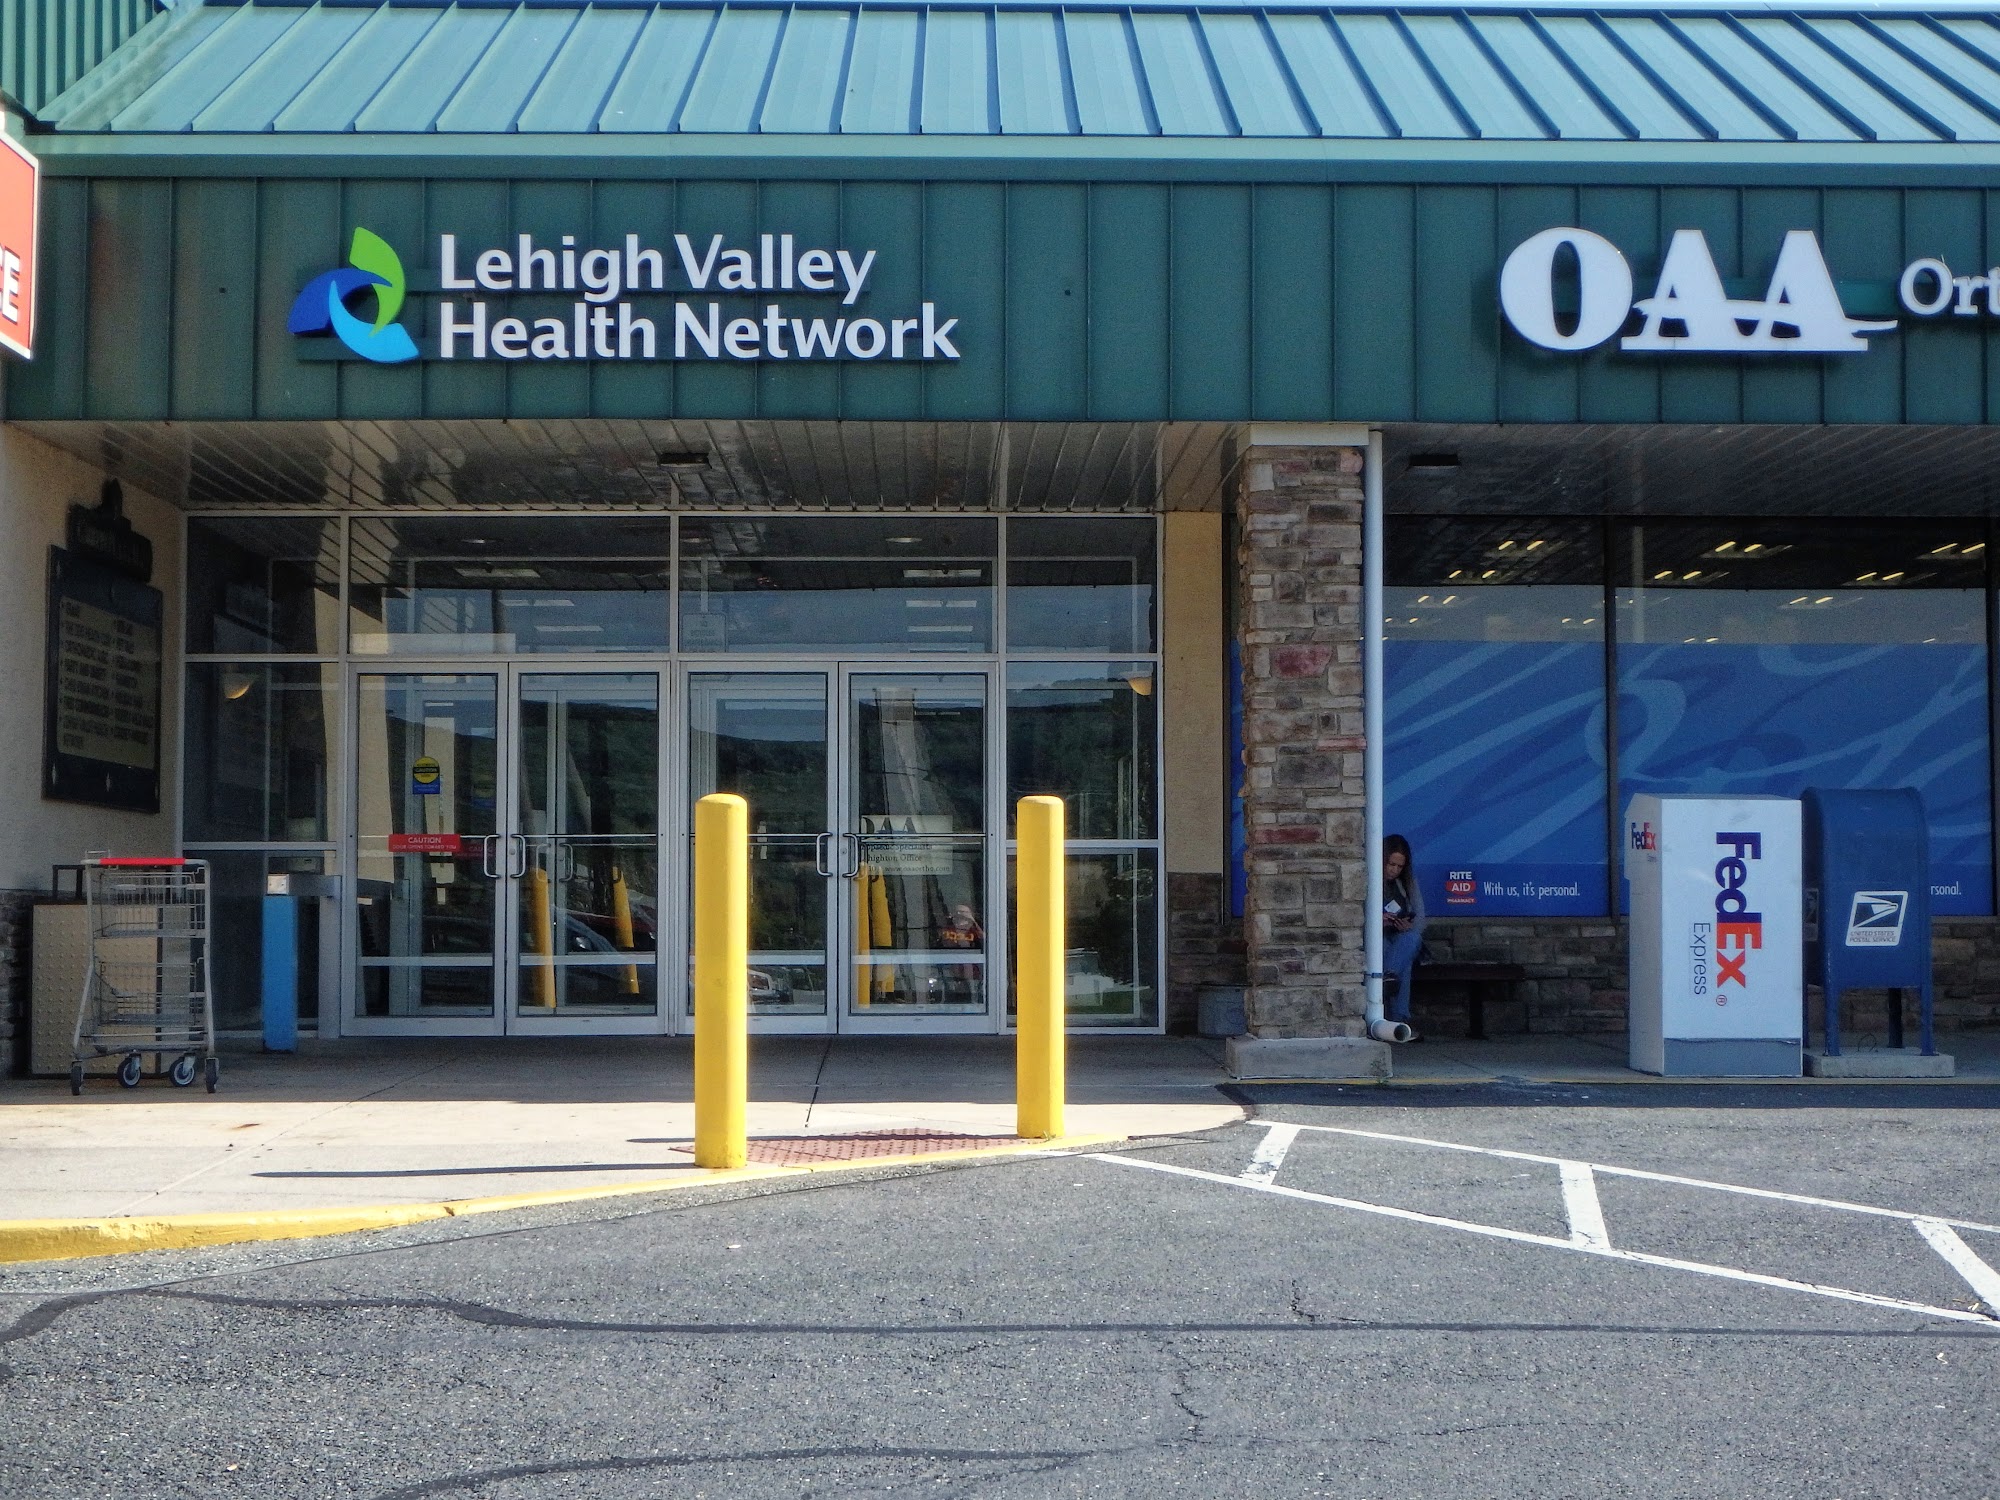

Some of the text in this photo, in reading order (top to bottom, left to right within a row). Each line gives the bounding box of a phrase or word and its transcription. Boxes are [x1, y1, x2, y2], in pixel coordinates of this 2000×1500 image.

[441, 234, 876, 304] Lehigh Valley
[1500, 226, 1898, 351] OAA
[440, 302, 960, 359] Health Network
[408, 836, 442, 844] CAUTION
[1631, 822, 1656, 850] FedEx
[1449, 871, 1472, 880] RITE
[1451, 882, 1471, 892] AID
[1930, 881, 1962, 896] rsonal.
[1484, 881, 1581, 900] With us, it's personal.
[1714, 831, 1762, 988] FedEx
[1689, 922, 1711, 995] Express
